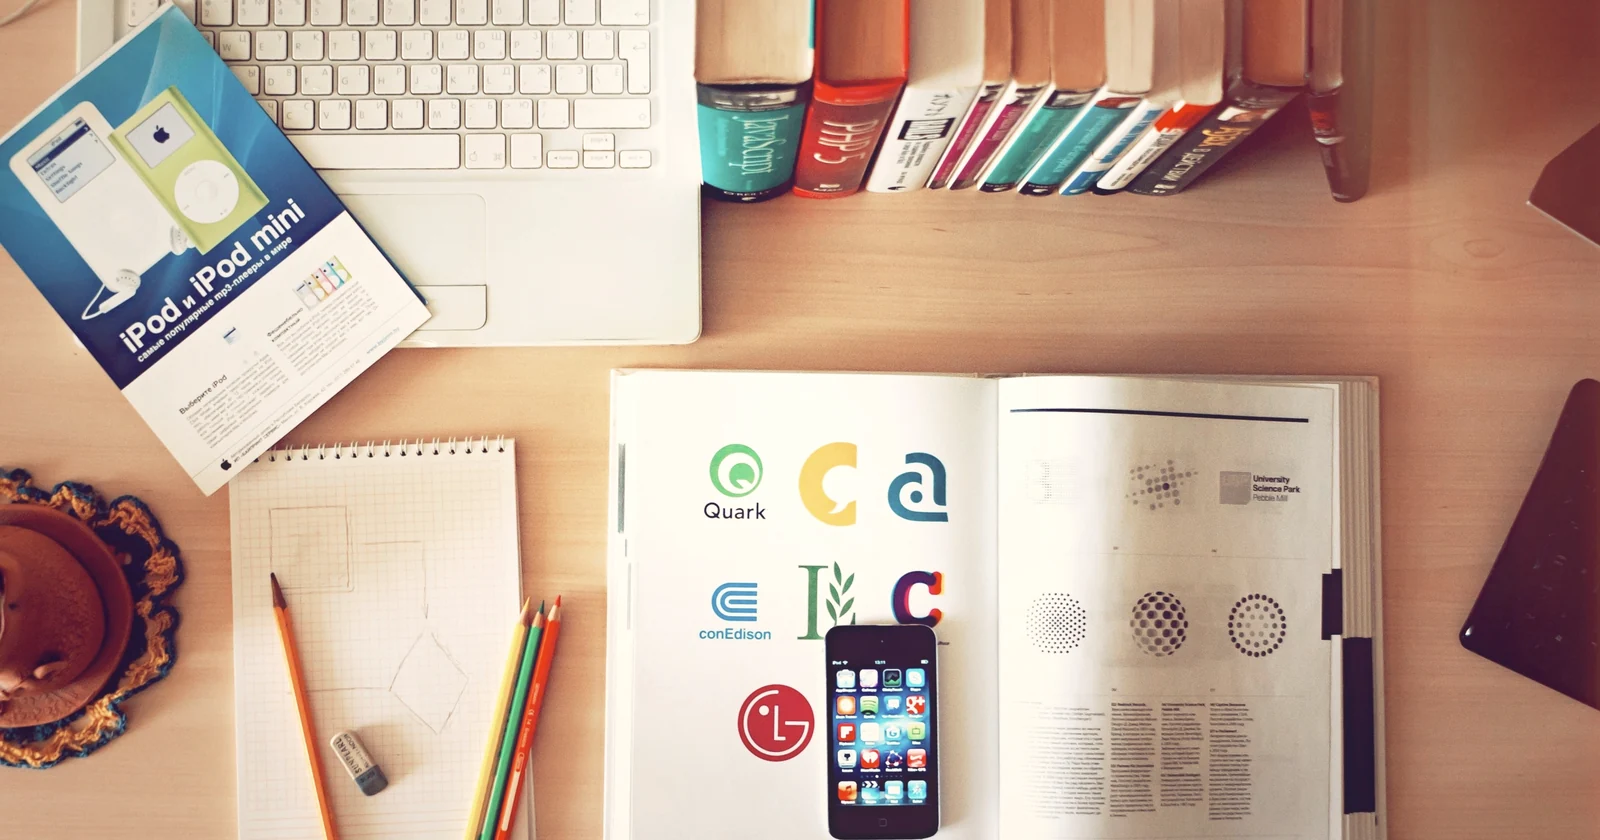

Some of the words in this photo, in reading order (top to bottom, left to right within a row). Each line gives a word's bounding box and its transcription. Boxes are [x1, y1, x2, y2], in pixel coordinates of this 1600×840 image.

[817, 119, 879, 152] PHP
[902, 119, 950, 142] RAILS
[1198, 126, 1251, 147] Ajax
[728, 114, 790, 175] JavaScript
[813, 151, 866, 165] 5
[45, 165, 66, 181] Settings
[55, 175, 78, 194] Backlight
[250, 198, 305, 251] mini
[189, 241, 252, 297] iPod
[137, 339, 165, 362] самые
[164, 299, 215, 341] популярные
[214, 258, 265, 301] mp3-плееры
[270, 236, 293, 257] мире
[182, 294, 197, 309] и
[119, 297, 182, 354] iPod
[179, 387, 212, 415] Выберите
[212, 374, 228, 389] iPod
[1253, 475, 1290, 485] University
[1253, 485, 1281, 493] Science
[1283, 485, 1300, 493] Park
[1253, 494, 1276, 502] Pebble
[1277, 494, 1288, 502] Mill
[704, 502, 766, 519] Quark
[699, 628, 771, 640] conEdison
[335, 738, 363, 774] SUNPEARL
